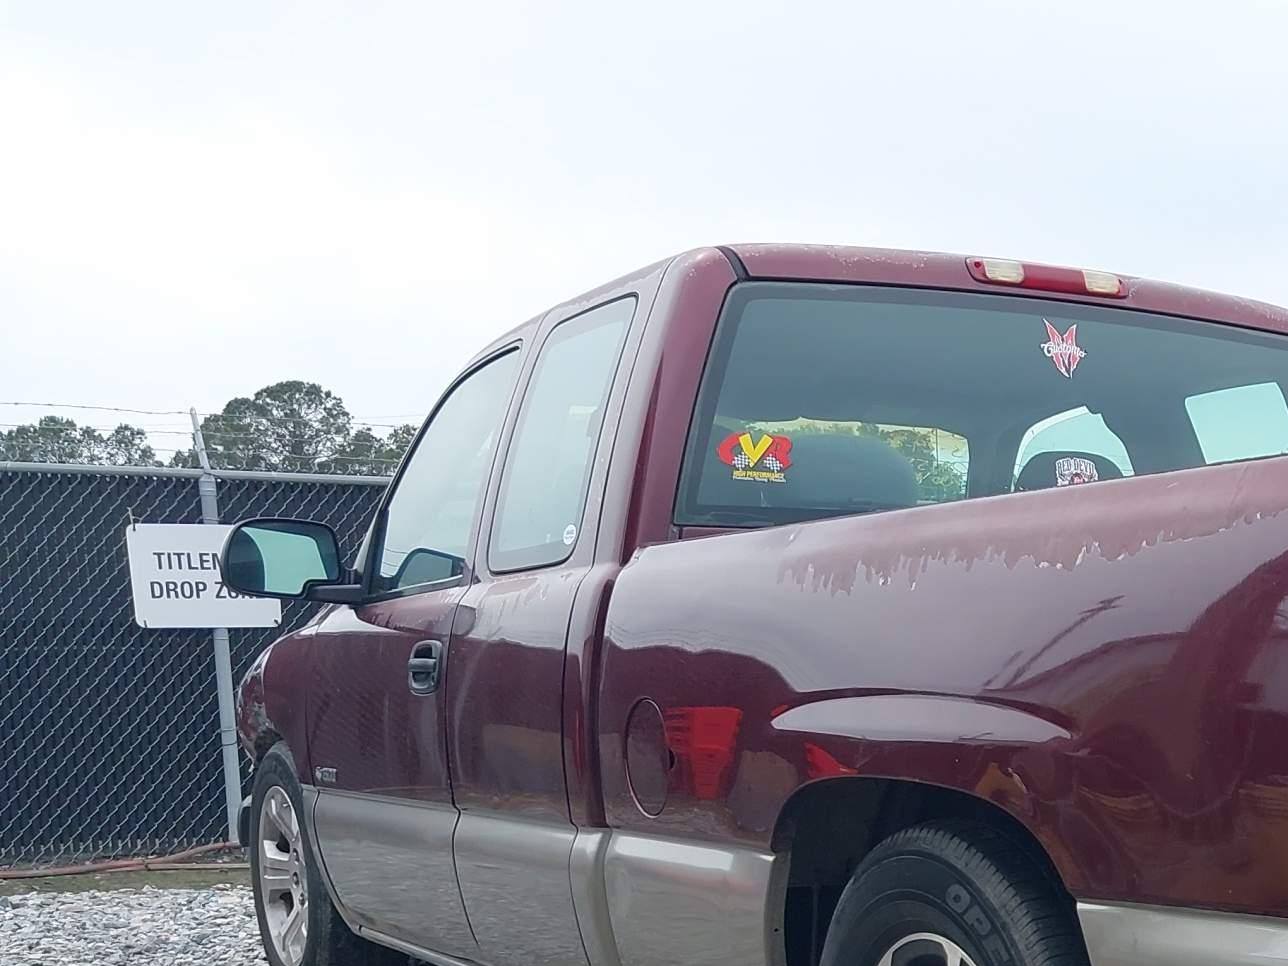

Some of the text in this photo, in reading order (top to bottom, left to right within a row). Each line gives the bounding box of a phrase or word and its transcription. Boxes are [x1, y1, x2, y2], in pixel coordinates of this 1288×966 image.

[1055, 457, 1096, 476] RED DEVIL
[150, 581, 207, 599] DROP
